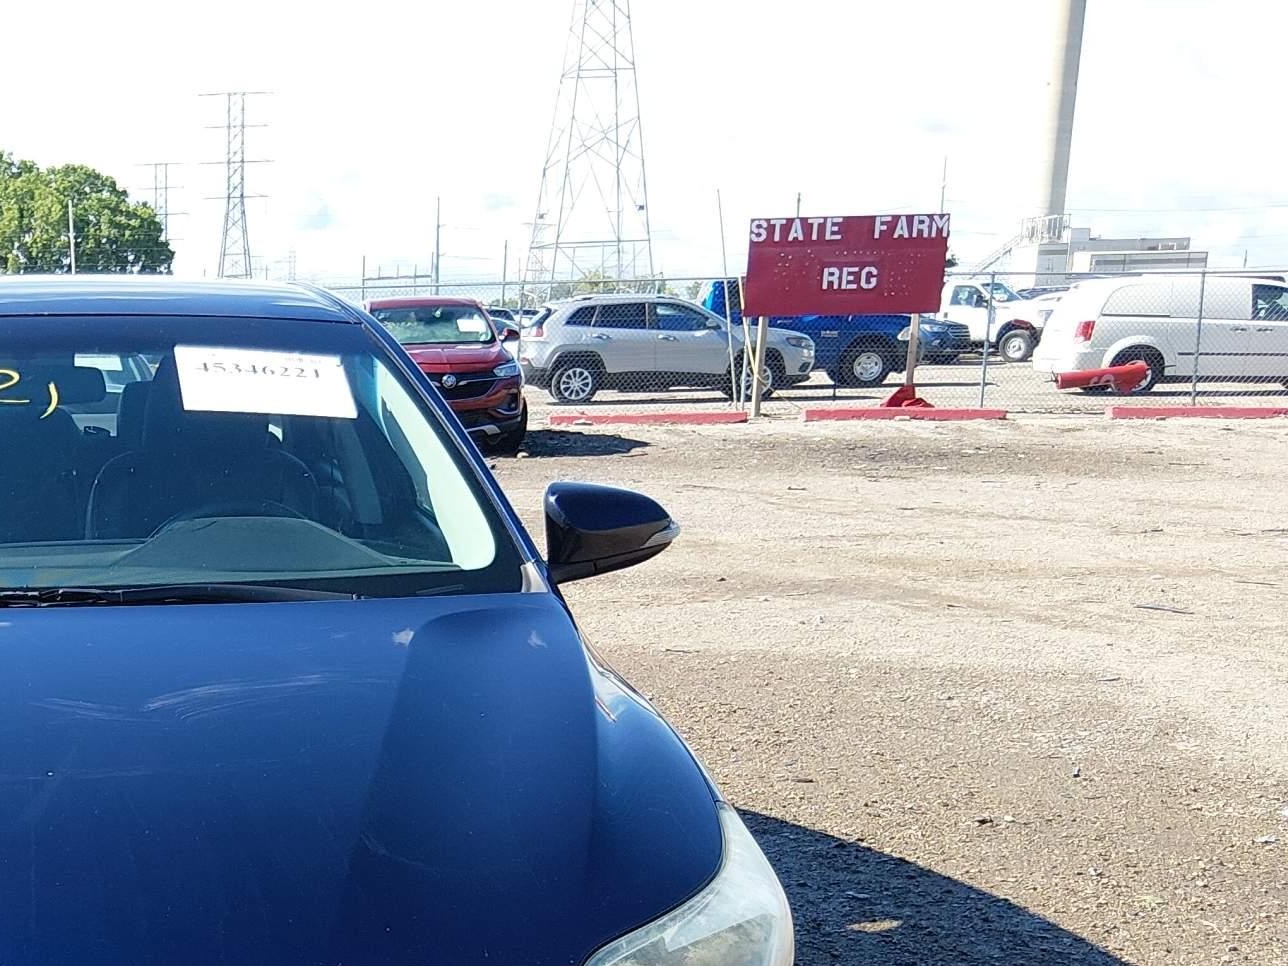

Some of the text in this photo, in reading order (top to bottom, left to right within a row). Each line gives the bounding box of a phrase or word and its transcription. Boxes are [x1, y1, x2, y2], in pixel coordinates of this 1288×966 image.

[750, 214, 950, 242] STATE FARM
[821, 266, 878, 289] REG
